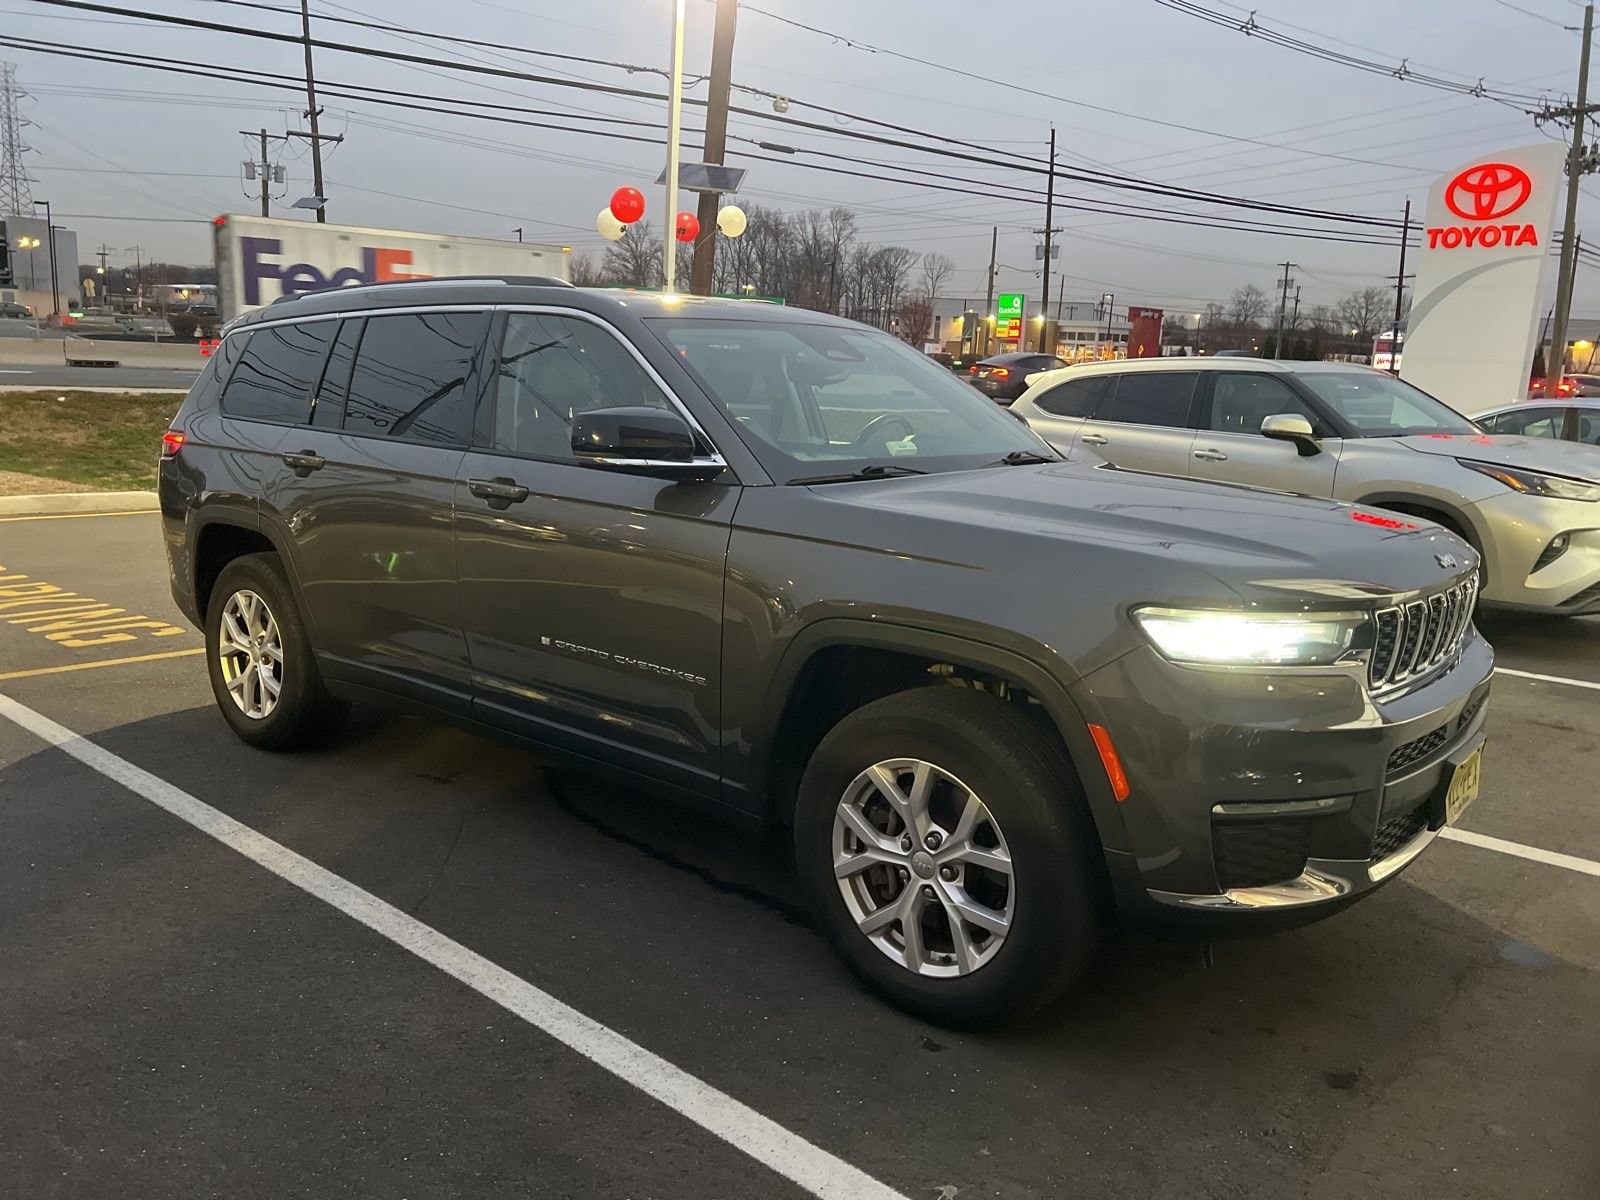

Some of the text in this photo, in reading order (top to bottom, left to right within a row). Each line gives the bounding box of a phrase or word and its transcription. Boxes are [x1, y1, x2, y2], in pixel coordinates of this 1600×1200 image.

[1427, 224, 1539, 250] TOYOTA
[240, 236, 433, 306] FedE
[554, 639, 708, 687] GRAND CHEROKEE
